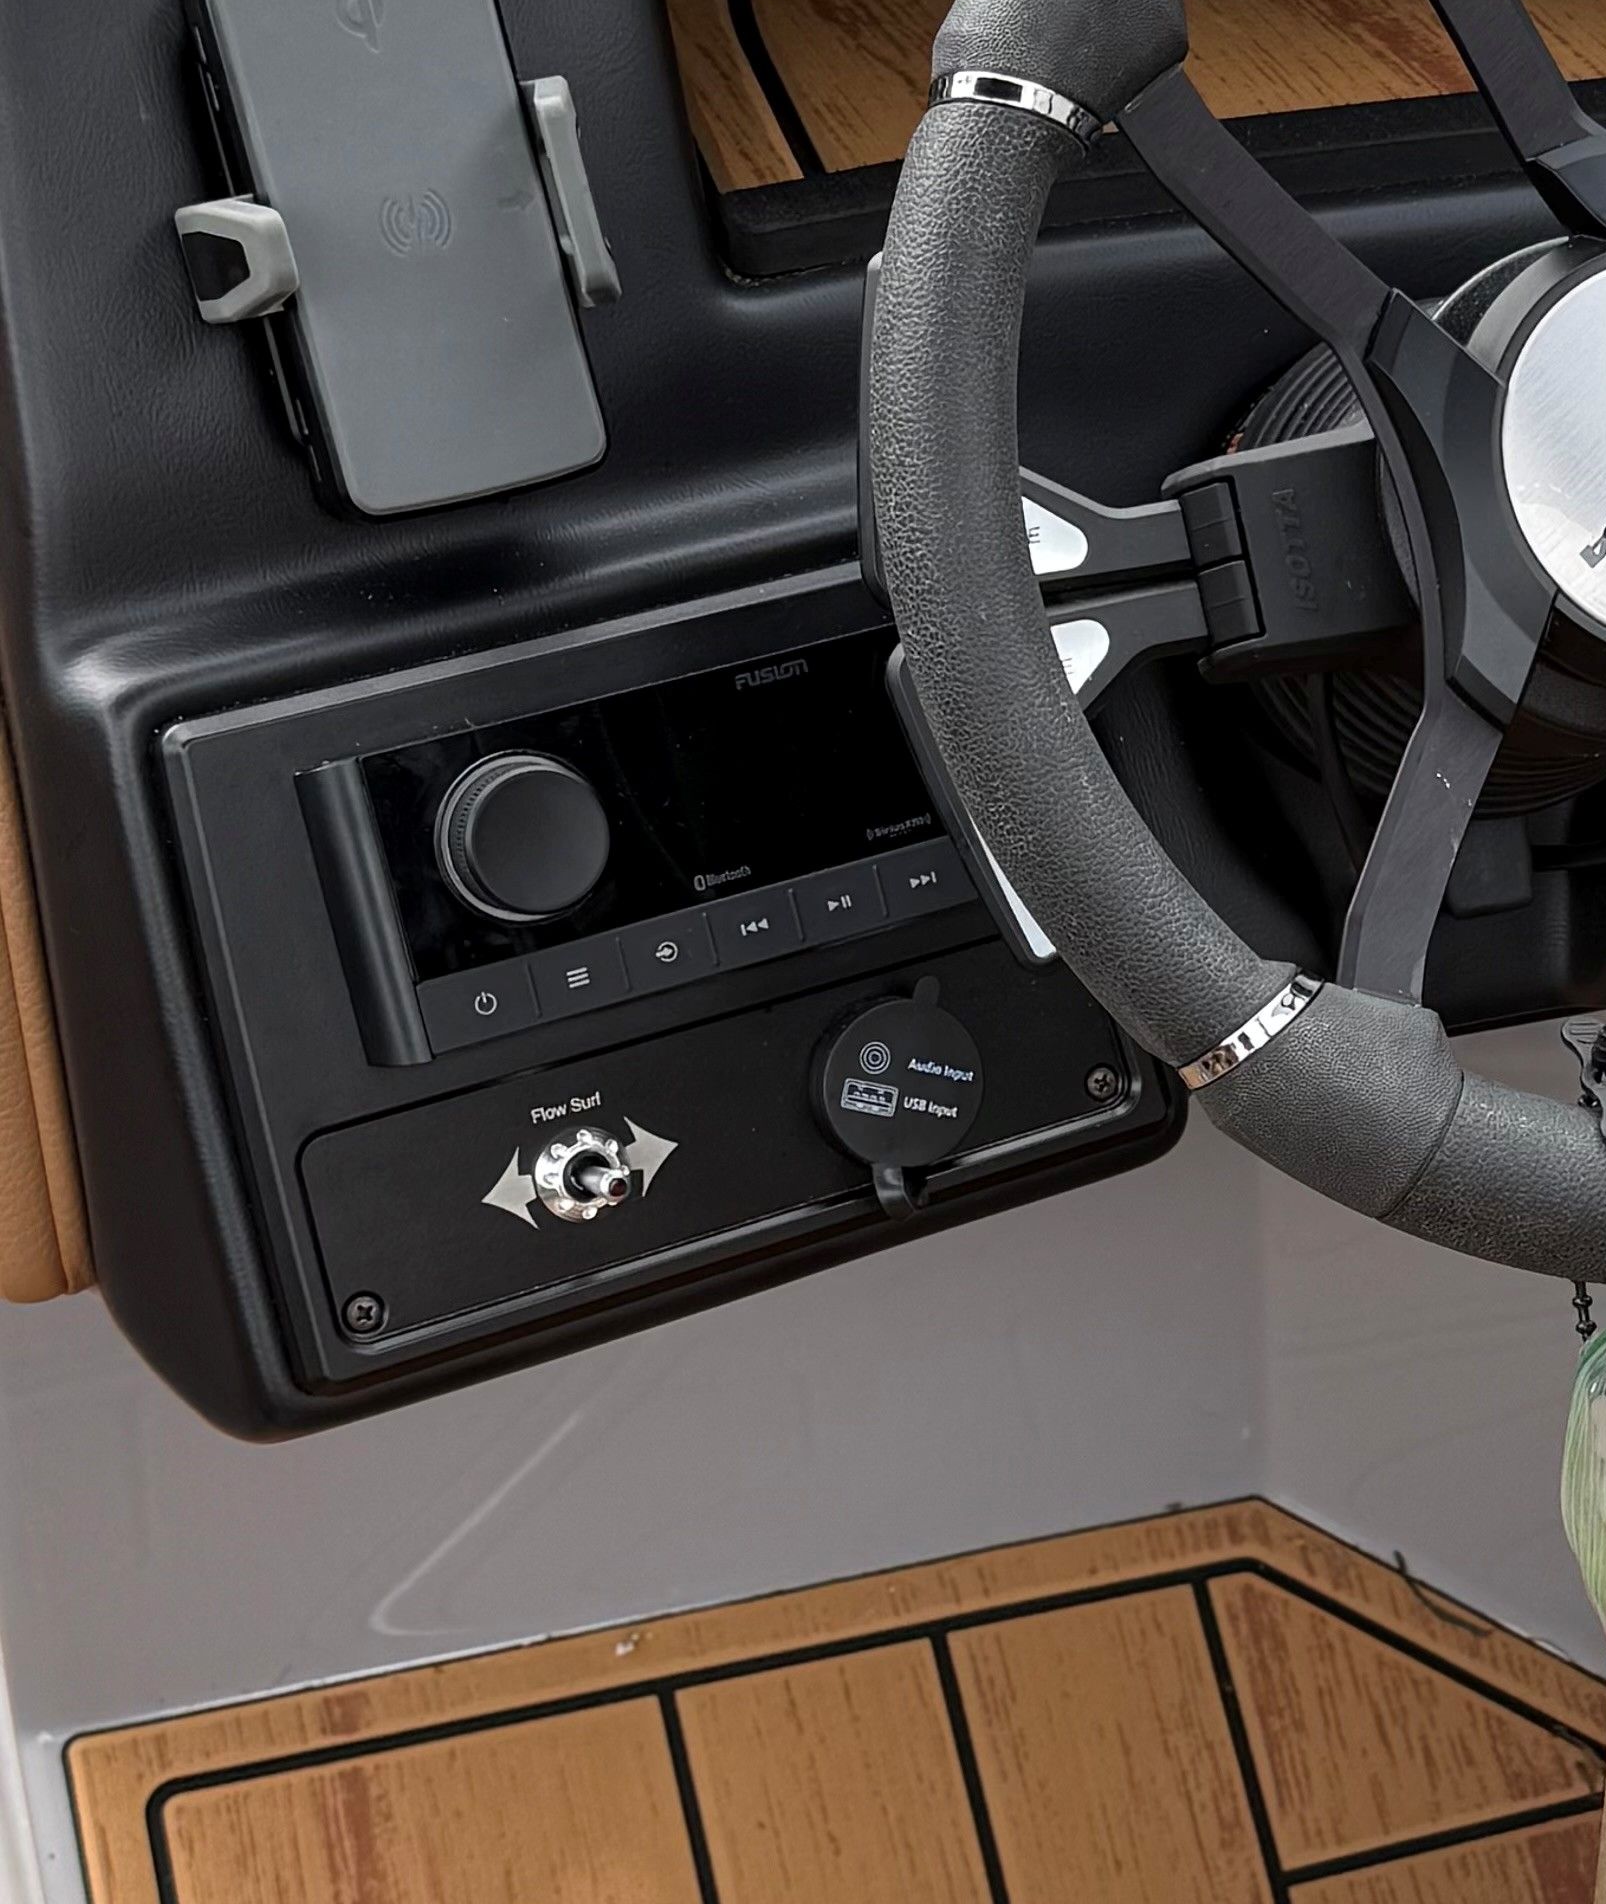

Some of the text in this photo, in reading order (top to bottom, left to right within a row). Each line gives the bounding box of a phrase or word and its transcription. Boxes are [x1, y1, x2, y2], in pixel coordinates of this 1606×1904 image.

[908, 1058, 974, 1082] Audio Input
[530, 1103, 567, 1125] Flow
[903, 1096, 958, 1119] USB Input
